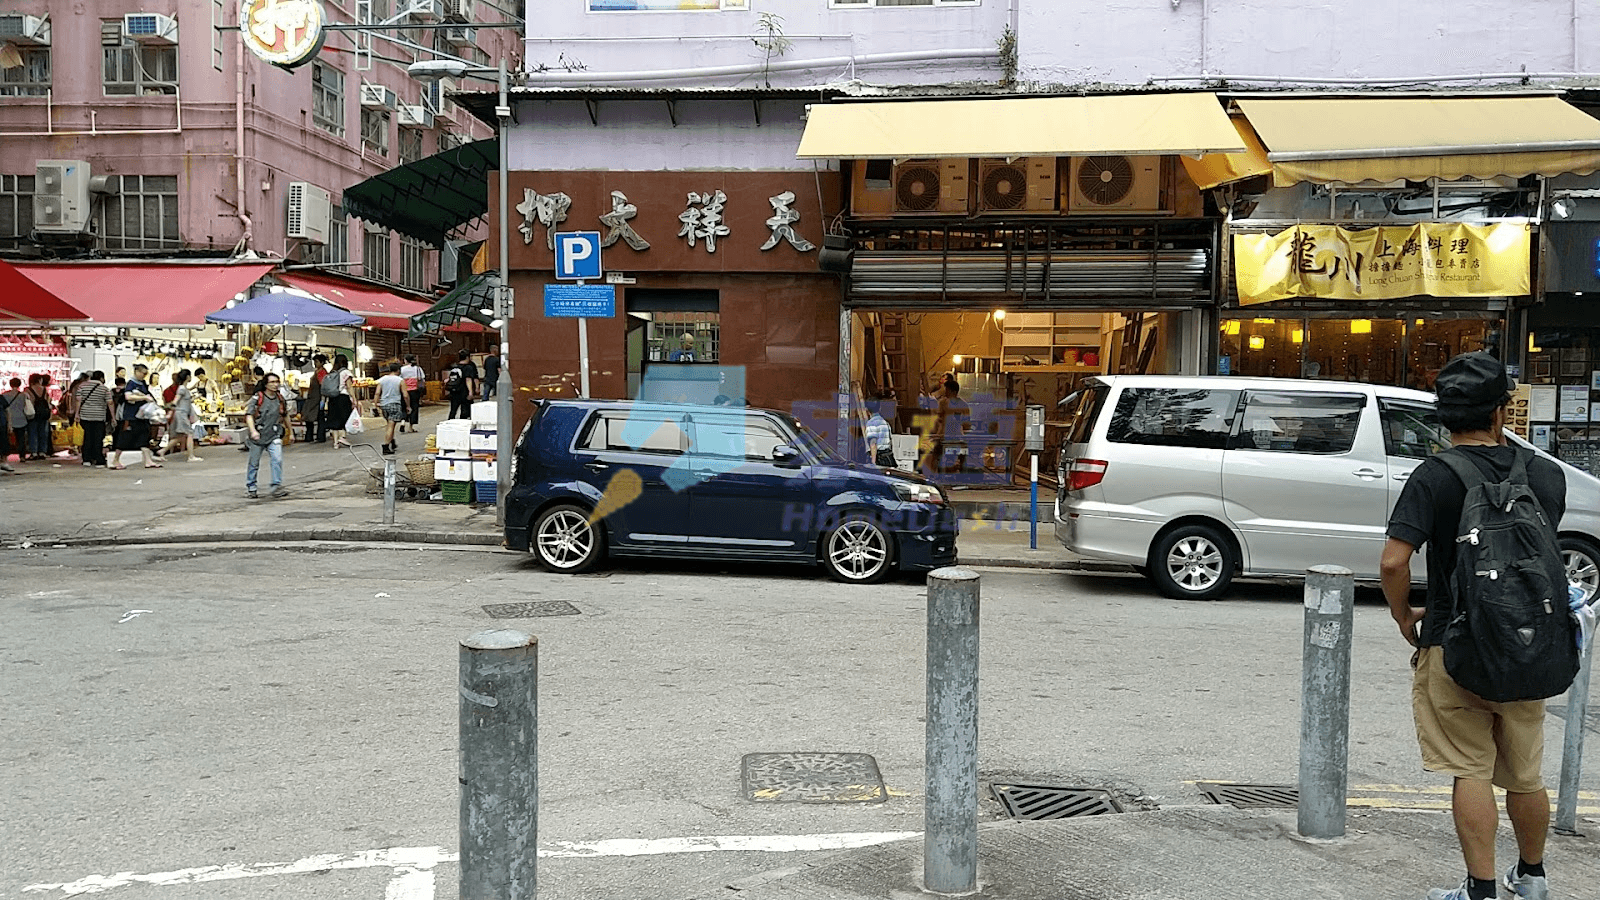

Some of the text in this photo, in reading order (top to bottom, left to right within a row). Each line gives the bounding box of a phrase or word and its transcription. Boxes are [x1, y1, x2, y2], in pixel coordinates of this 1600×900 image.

[250, 0, 309, 53] 押
[562, 236, 593, 275] P
[1285, 231, 1365, 295] 龍川
[1376, 236, 1469, 258] 上海料理
[1368, 276, 1389, 288] Long
[1389, 272, 1412, 284] Chuan
[1440, 272, 1481, 282] Restaurant
